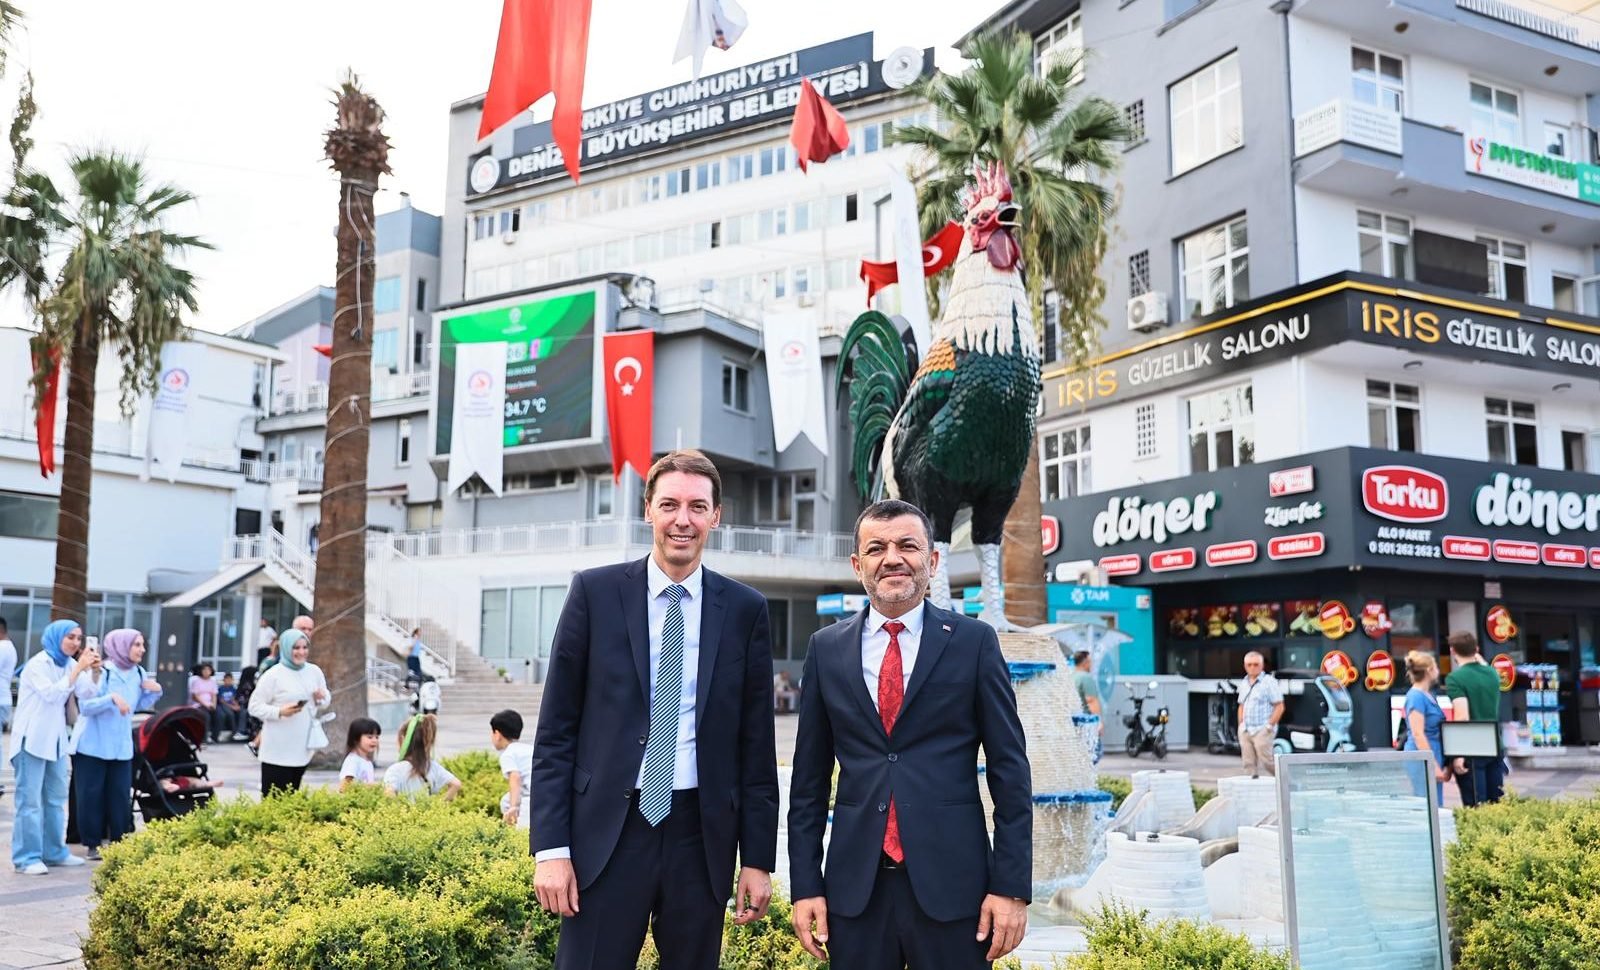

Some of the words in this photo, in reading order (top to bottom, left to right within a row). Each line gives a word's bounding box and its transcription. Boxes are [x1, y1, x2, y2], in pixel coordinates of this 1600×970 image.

[582, 98, 645, 131] RKİYE
[648, 53, 799, 112] CUMHURİYETİ
[508, 146, 582, 177] DENİZ
[588, 104, 725, 158] BÜYÜKŞEHİR
[729, 61, 869, 121] BELEDYESİ
[1128, 342, 1213, 386] GÜZELLİK
[1221, 313, 1311, 360] SALONU
[1446, 318, 1536, 357] GÜZELLİK
[1371, 473, 1438, 510] Torku
[1475, 472, 1600, 536] döner
[1093, 490, 1217, 548] döner
[1377, 526, 1398, 540] ALO
[1399, 527, 1432, 542] PAKET
[1368, 540, 1378, 554] 0
[1085, 588, 1110, 601] TAM
